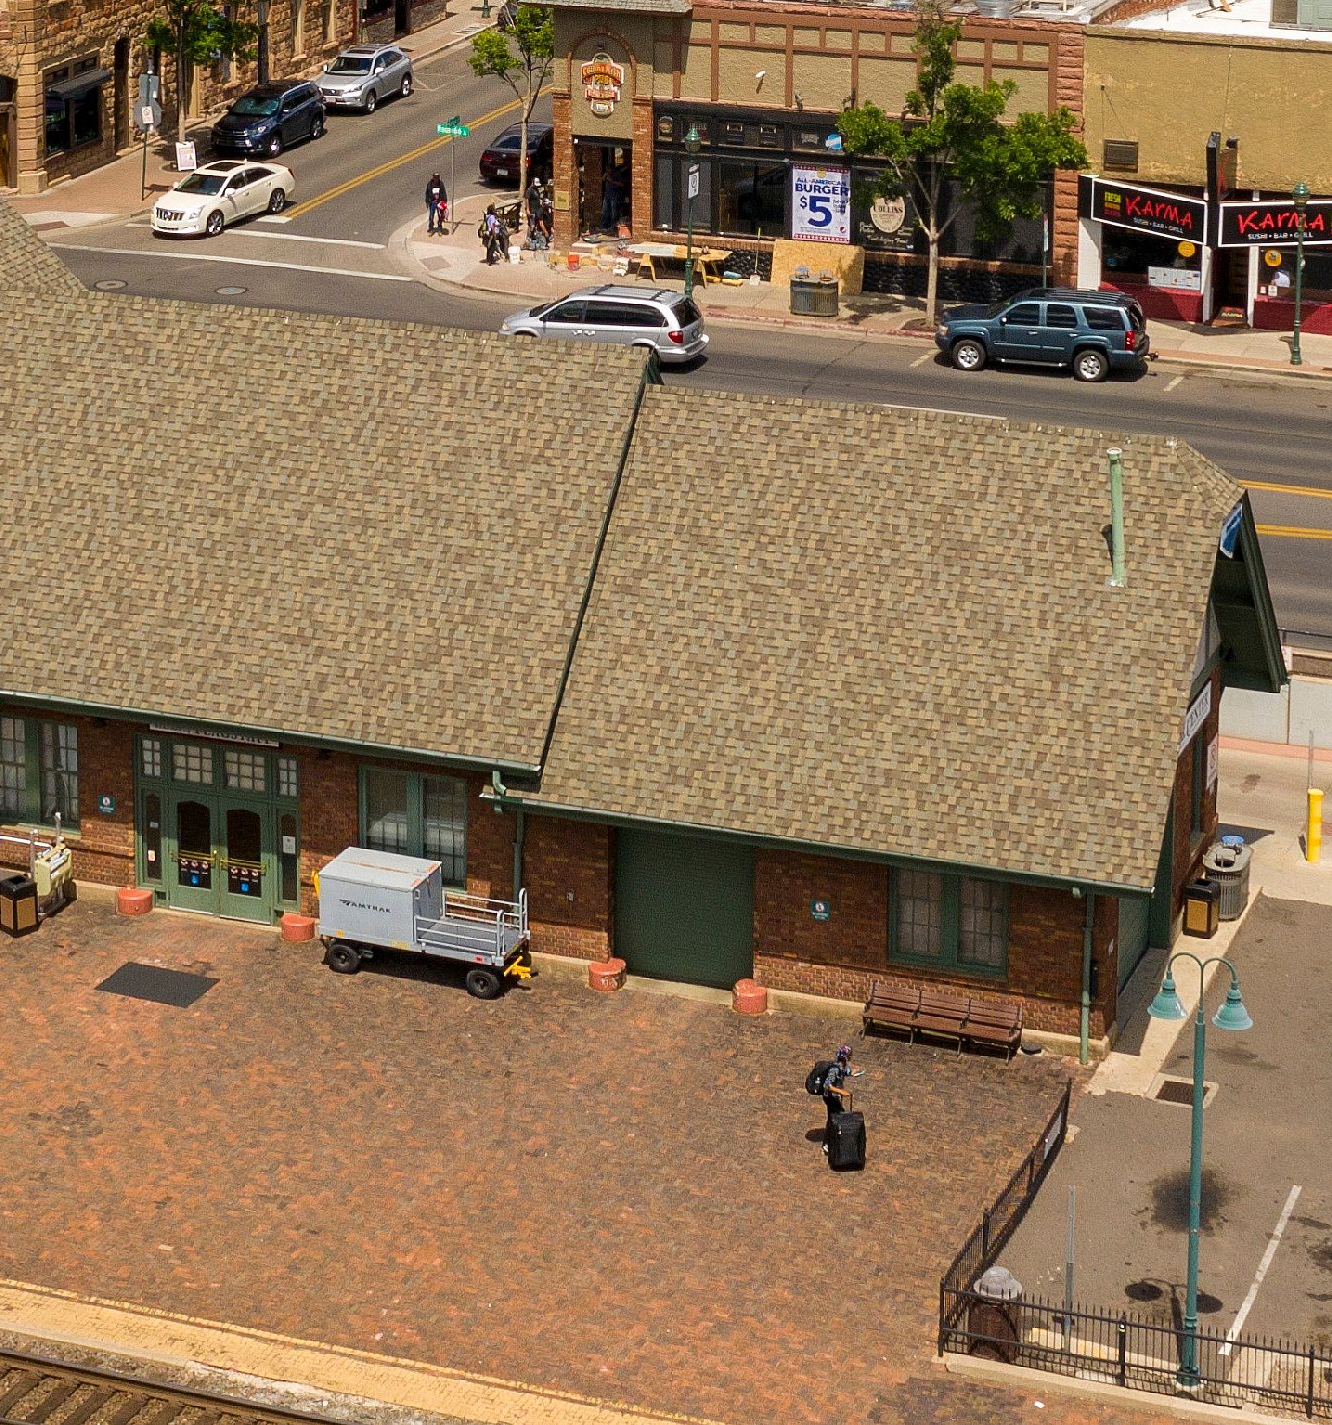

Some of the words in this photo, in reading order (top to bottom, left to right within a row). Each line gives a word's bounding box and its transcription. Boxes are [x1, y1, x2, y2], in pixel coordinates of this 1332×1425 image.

[796, 177, 847, 187] ALL-AMERICAN
[795, 183, 849, 196] BURGER
[351, 901, 392, 914] AMTRAK
